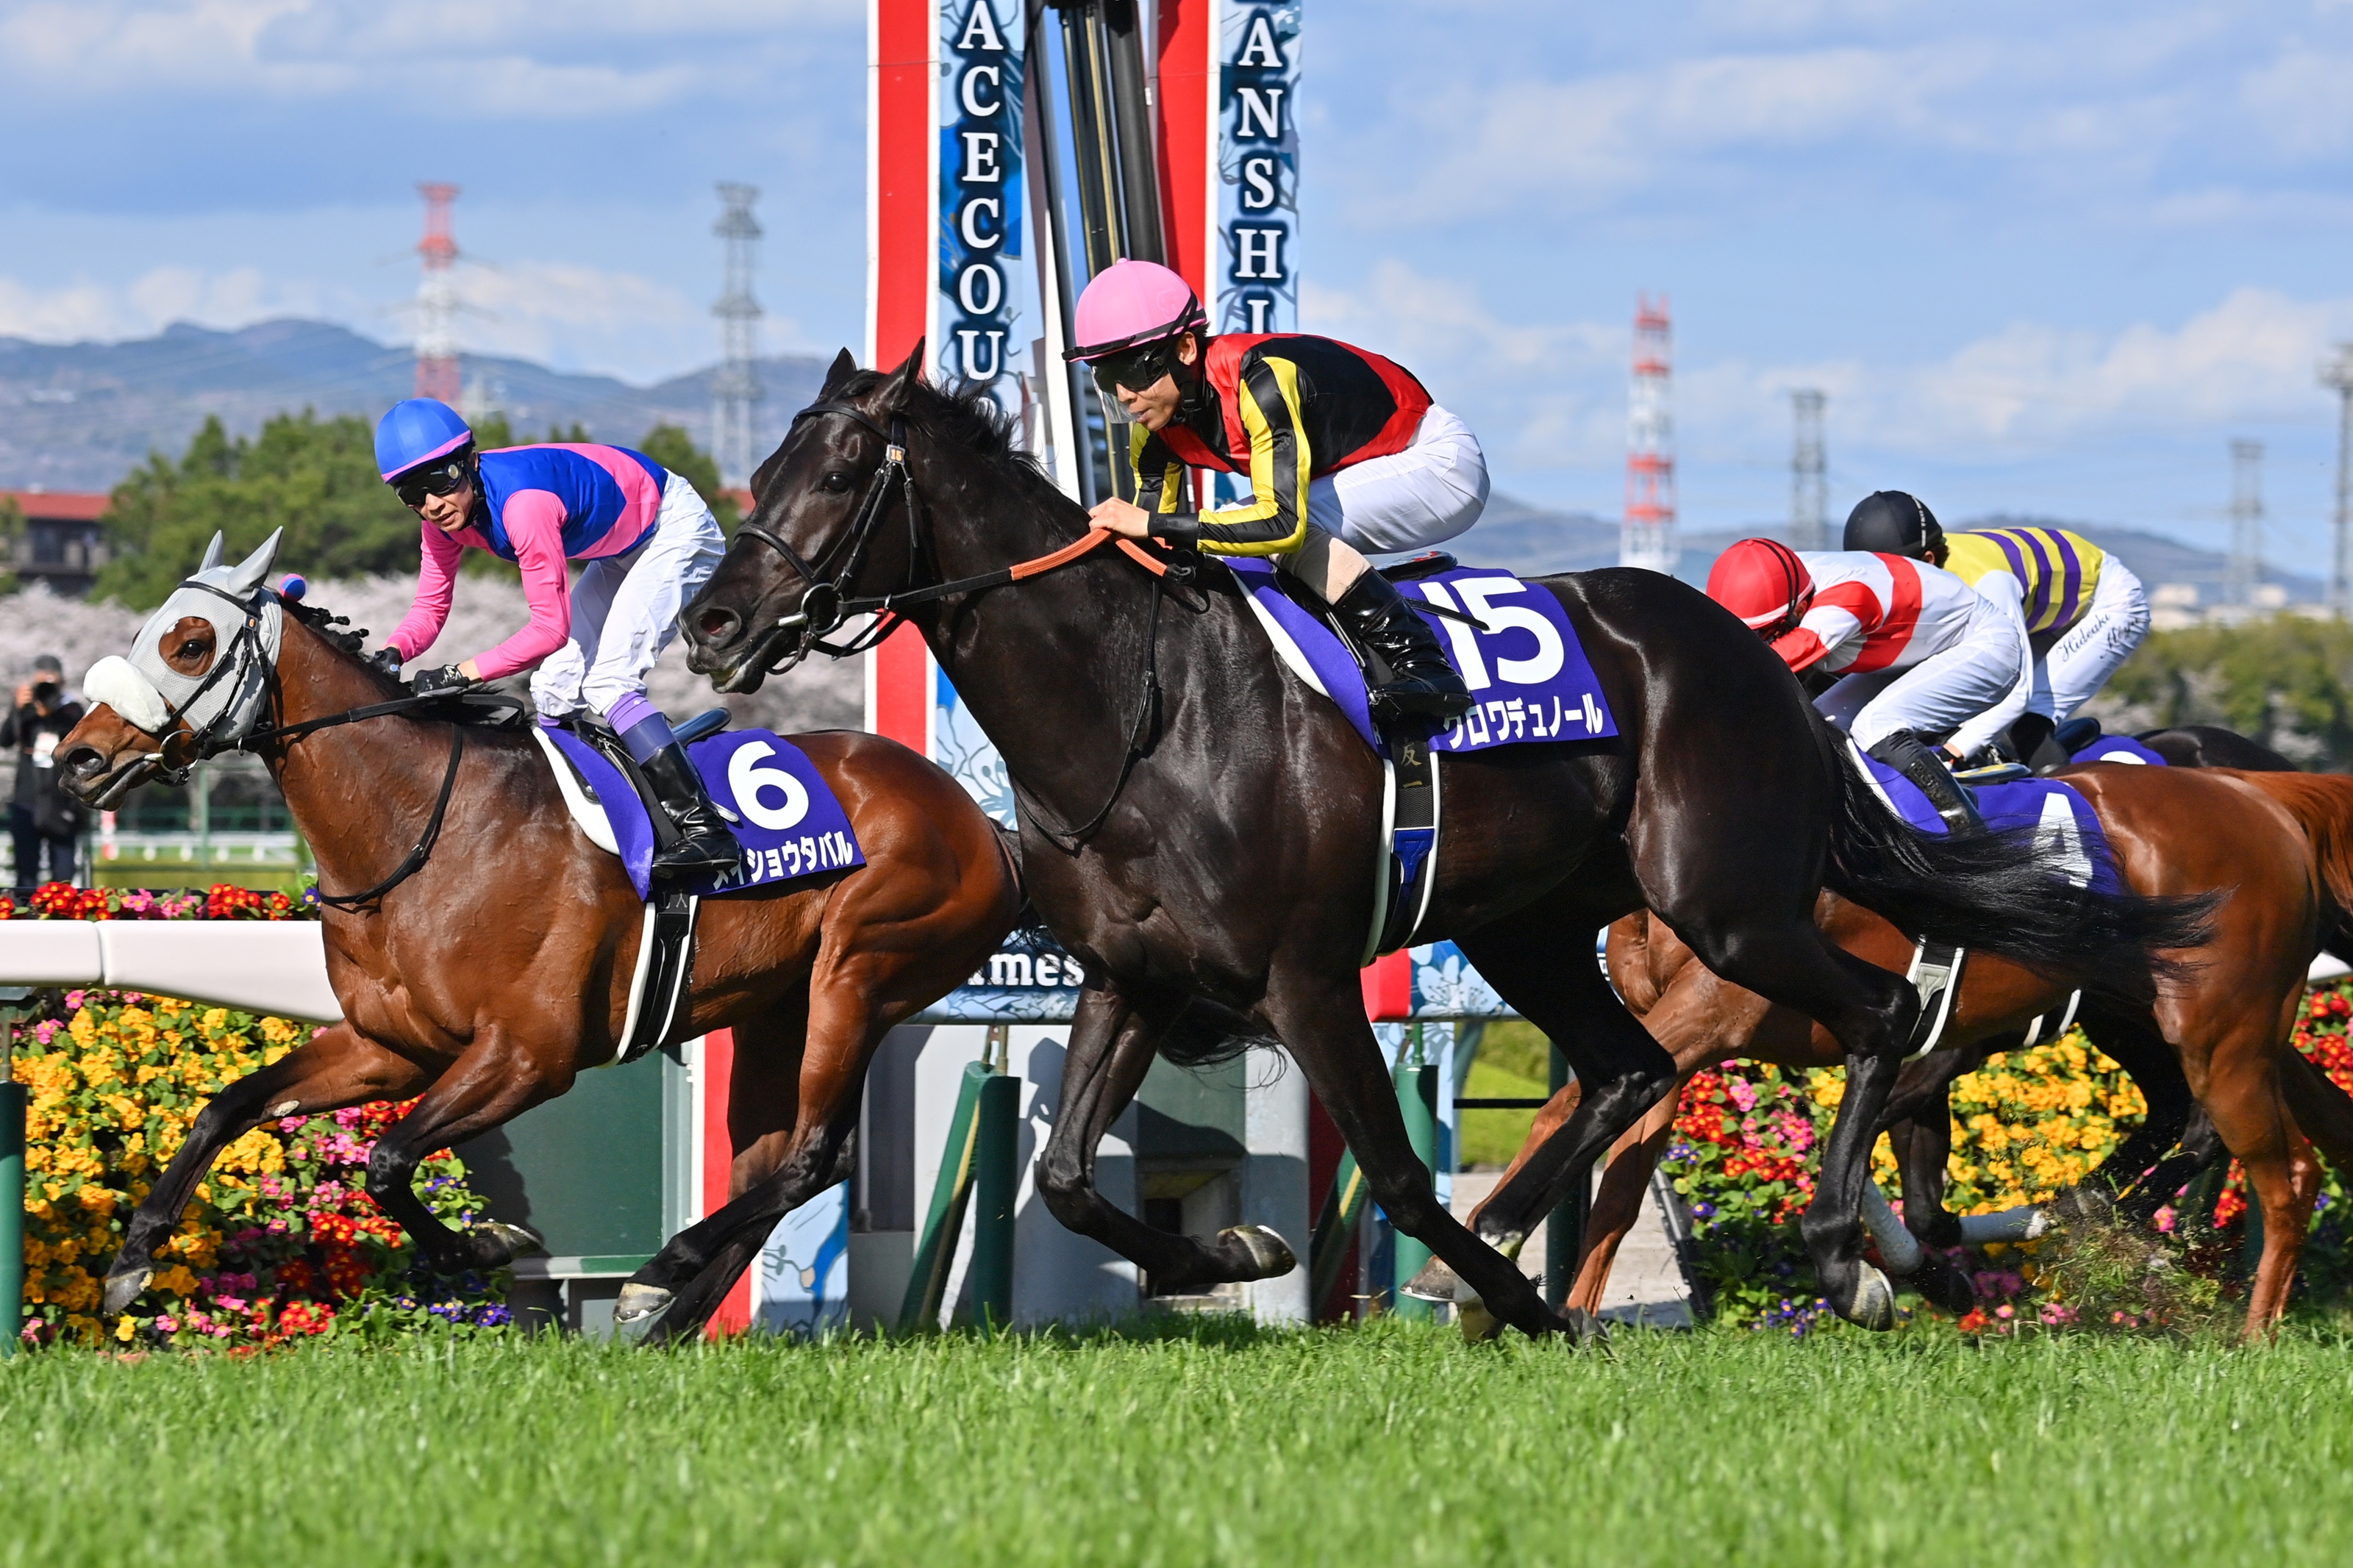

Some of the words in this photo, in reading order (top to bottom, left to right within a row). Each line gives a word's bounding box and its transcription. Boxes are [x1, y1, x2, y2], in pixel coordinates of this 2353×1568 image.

[957, 0, 1004, 423] ACECOU
[890, 448, 902, 462] 15
[1418, 577, 1564, 690] 15
[1443, 693, 1603, 749] クロワデュノール
[728, 740, 809, 830] 6
